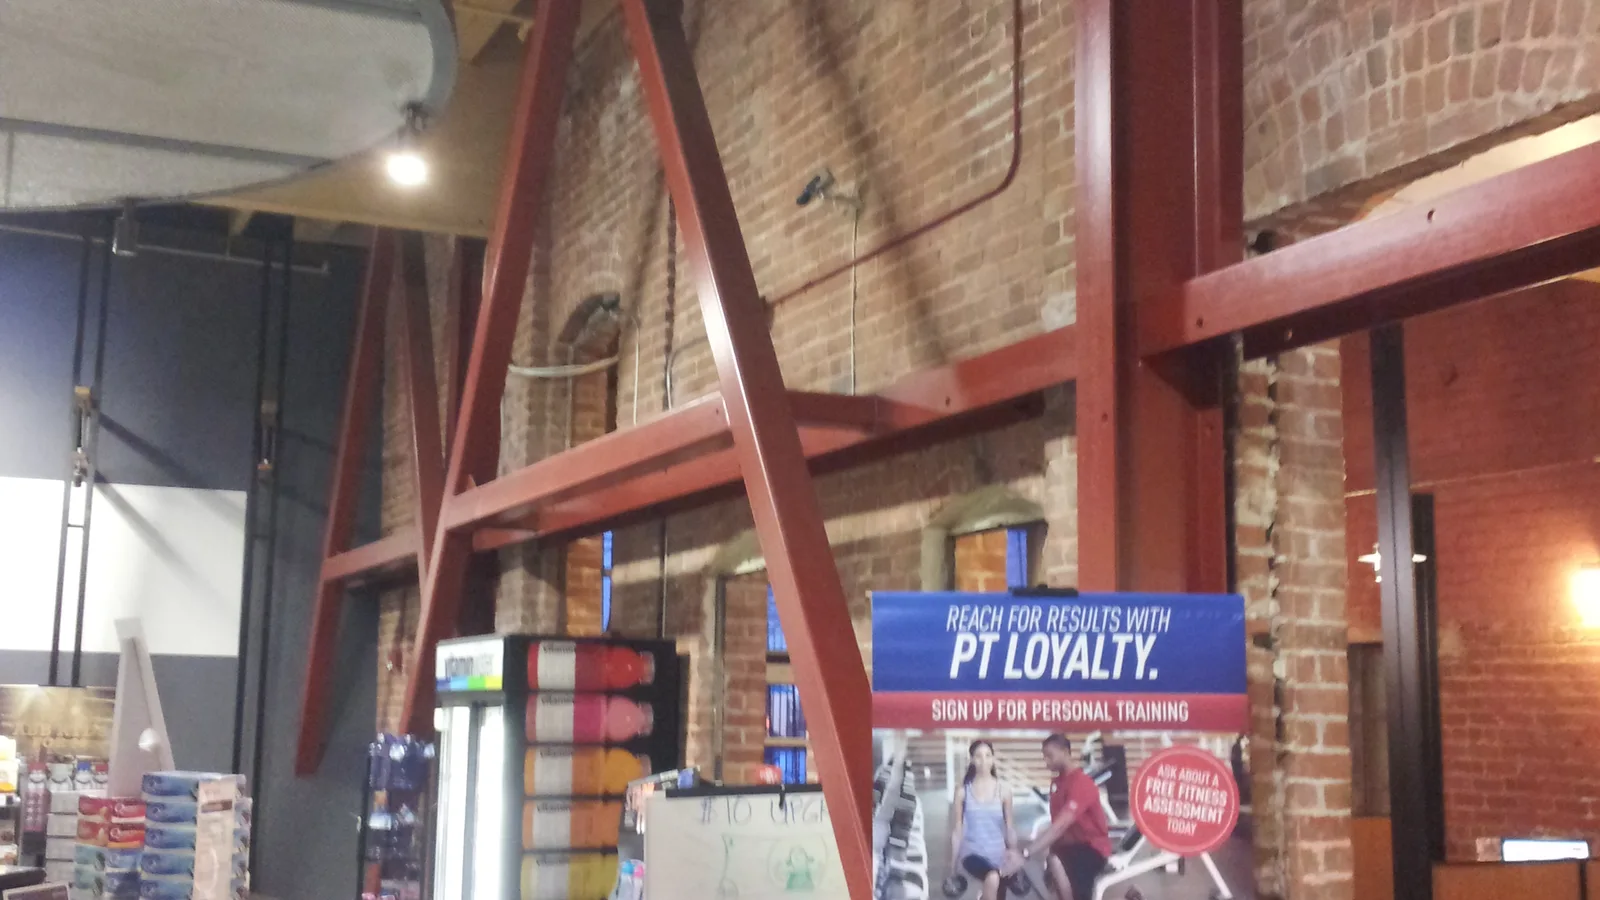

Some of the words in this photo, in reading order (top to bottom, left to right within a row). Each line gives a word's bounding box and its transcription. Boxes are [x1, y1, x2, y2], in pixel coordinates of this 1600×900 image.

[946, 604, 1004, 632] REACH
[1008, 606, 1042, 632] FOR
[1046, 606, 1122, 633] RESULTS
[1126, 607, 1172, 633] WITH
[950, 632, 1000, 680] PT
[1003, 632, 1159, 680] LOYALTY.
[932, 699, 968, 722] SIGN
[972, 700, 993, 722] UP
[998, 700, 1028, 722] FOR
[1032, 700, 1112, 722] PERSONAL
[1116, 700, 1189, 722] TRAINING
[1157, 764, 1178, 780] ASK
[1179, 767, 1211, 785] ABOUT
[1212, 773, 1219, 788] A
[1145, 776, 1176, 798] FREE
[1178, 782, 1228, 808] FITNESS
[1143, 795, 1225, 825] ASSESSMENT
[1167, 816, 1197, 837] TODAY
